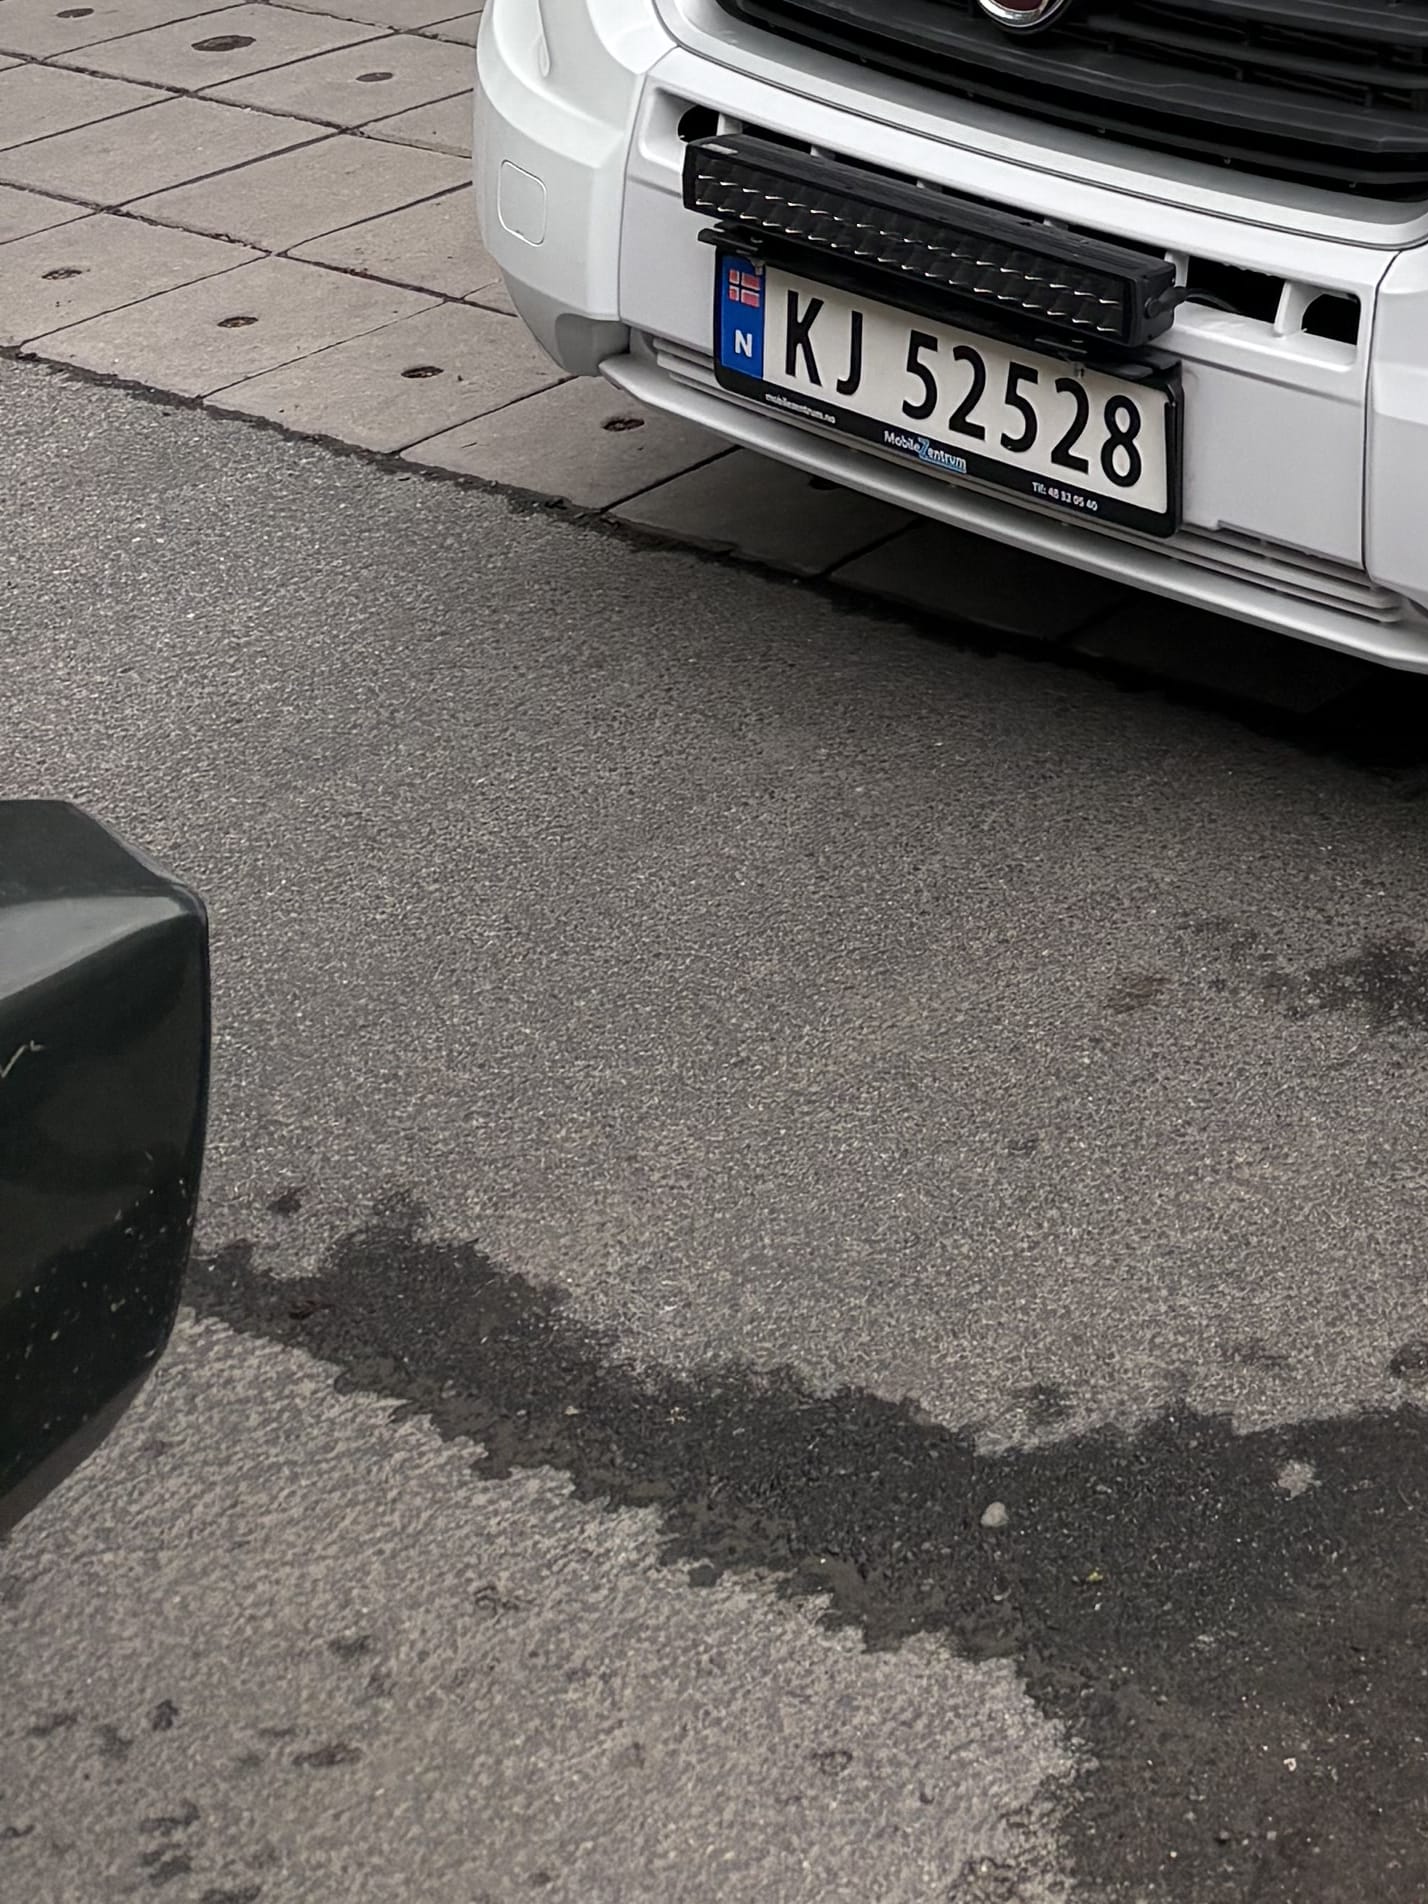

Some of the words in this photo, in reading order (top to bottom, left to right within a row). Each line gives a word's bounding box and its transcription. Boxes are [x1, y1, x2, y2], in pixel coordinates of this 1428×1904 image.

[735, 328, 753, 359] N
[785, 289, 863, 397] KJ
[900, 329, 1143, 489] 52528
[884, 430, 967, 474] MobileZentrum
